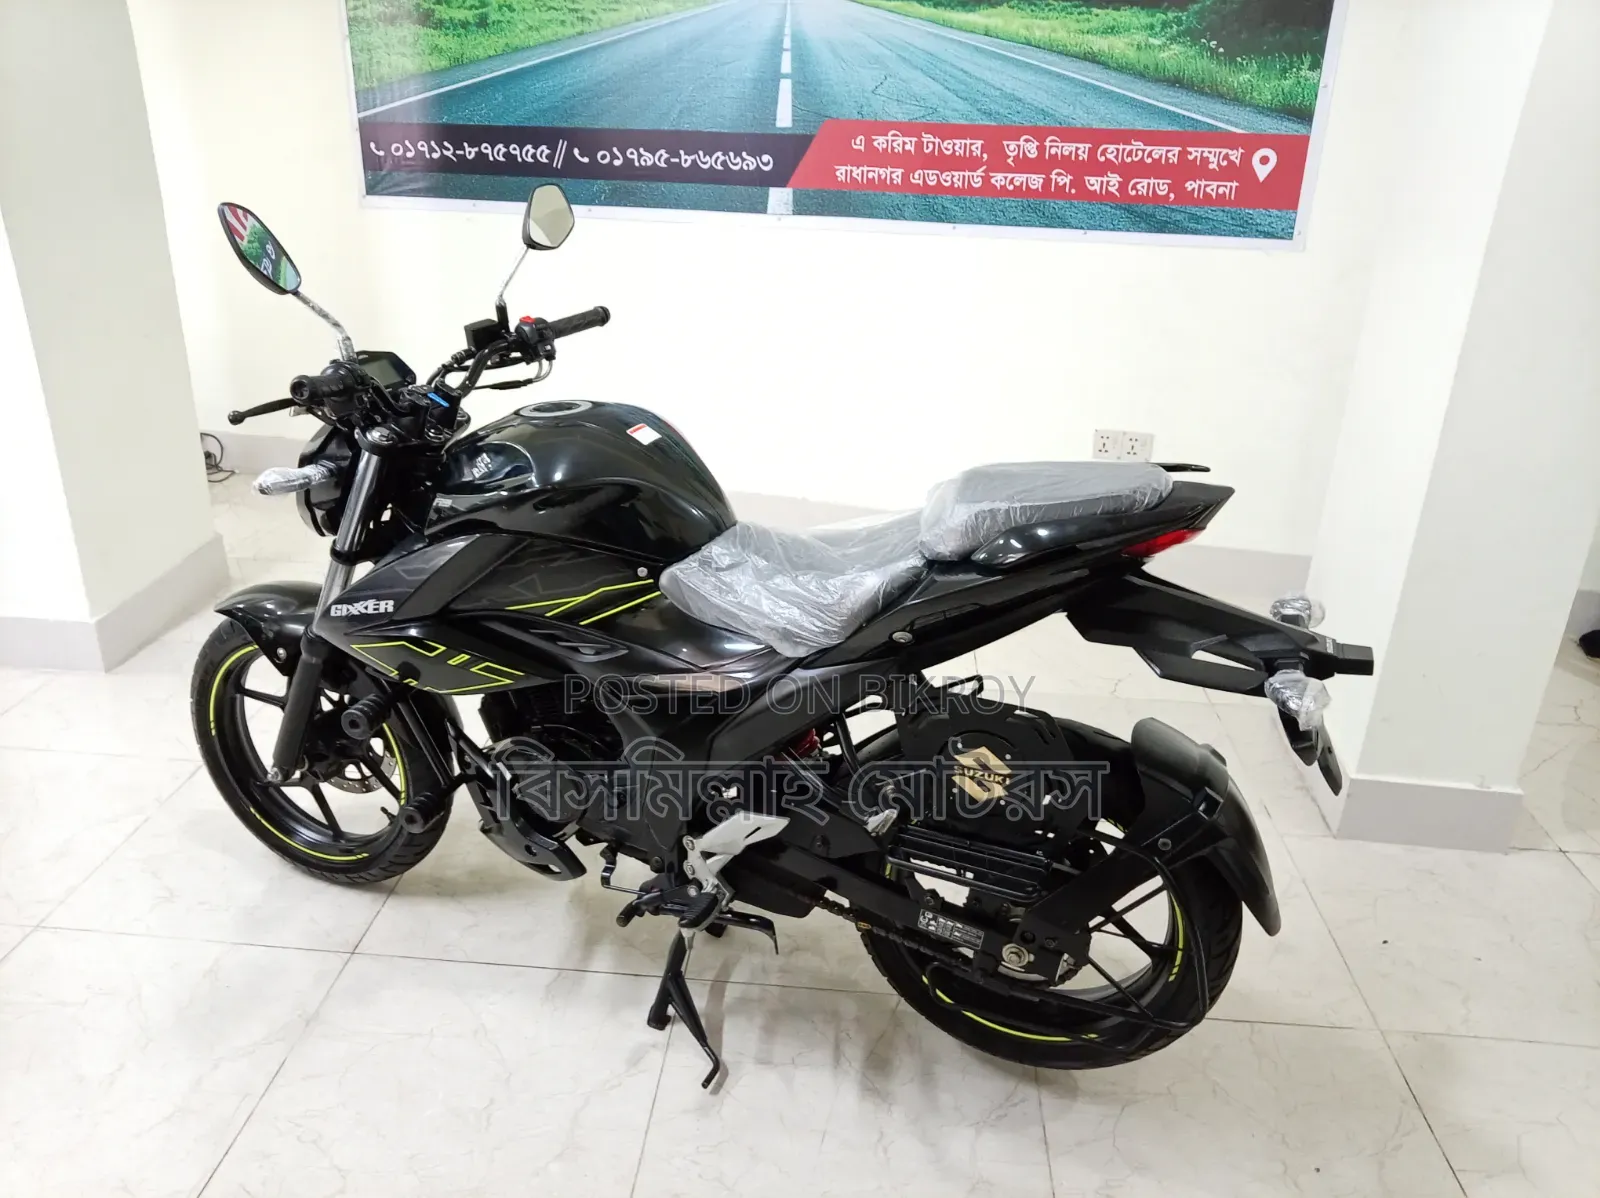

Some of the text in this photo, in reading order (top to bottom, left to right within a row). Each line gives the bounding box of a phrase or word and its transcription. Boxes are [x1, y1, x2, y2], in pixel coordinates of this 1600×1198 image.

[597, 146, 774, 171] ০১৭৯৫-৮৬৫৬৯৩
[851, 130, 1244, 171] এ করিম টাওয়ার, তৃপ্তি নিলয় হোটেলের সম্মুখে
[834, 164, 905, 186] রাধানগর
[989, 172, 1045, 192] কলেজ
[1049, 168, 1076, 198] পি.
[1084, 172, 1123, 197] আই
[1128, 176, 1175, 201] রোড,
[1184, 178, 1240, 201] পাবনা
[330, 599, 394, 617] GIXXER
[953, 765, 1010, 785] SUZUKI
